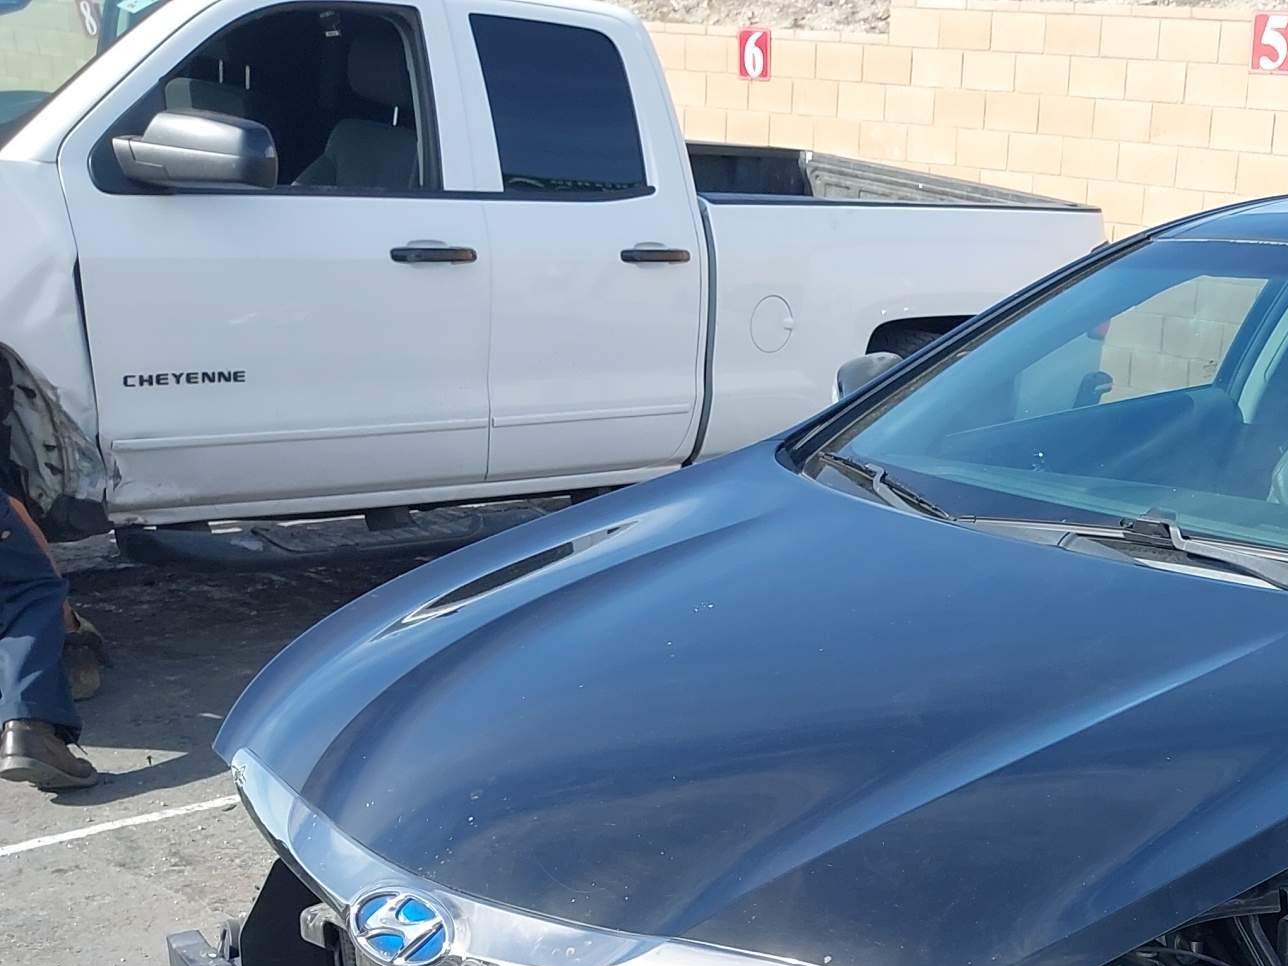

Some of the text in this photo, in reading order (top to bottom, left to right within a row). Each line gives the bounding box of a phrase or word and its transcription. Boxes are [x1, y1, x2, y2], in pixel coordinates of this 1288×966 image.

[80, 1, 97, 35] 8
[744, 31, 764, 79] 6
[1259, 15, 1288, 70] 5
[122, 370, 247, 388] CHEYENNE
